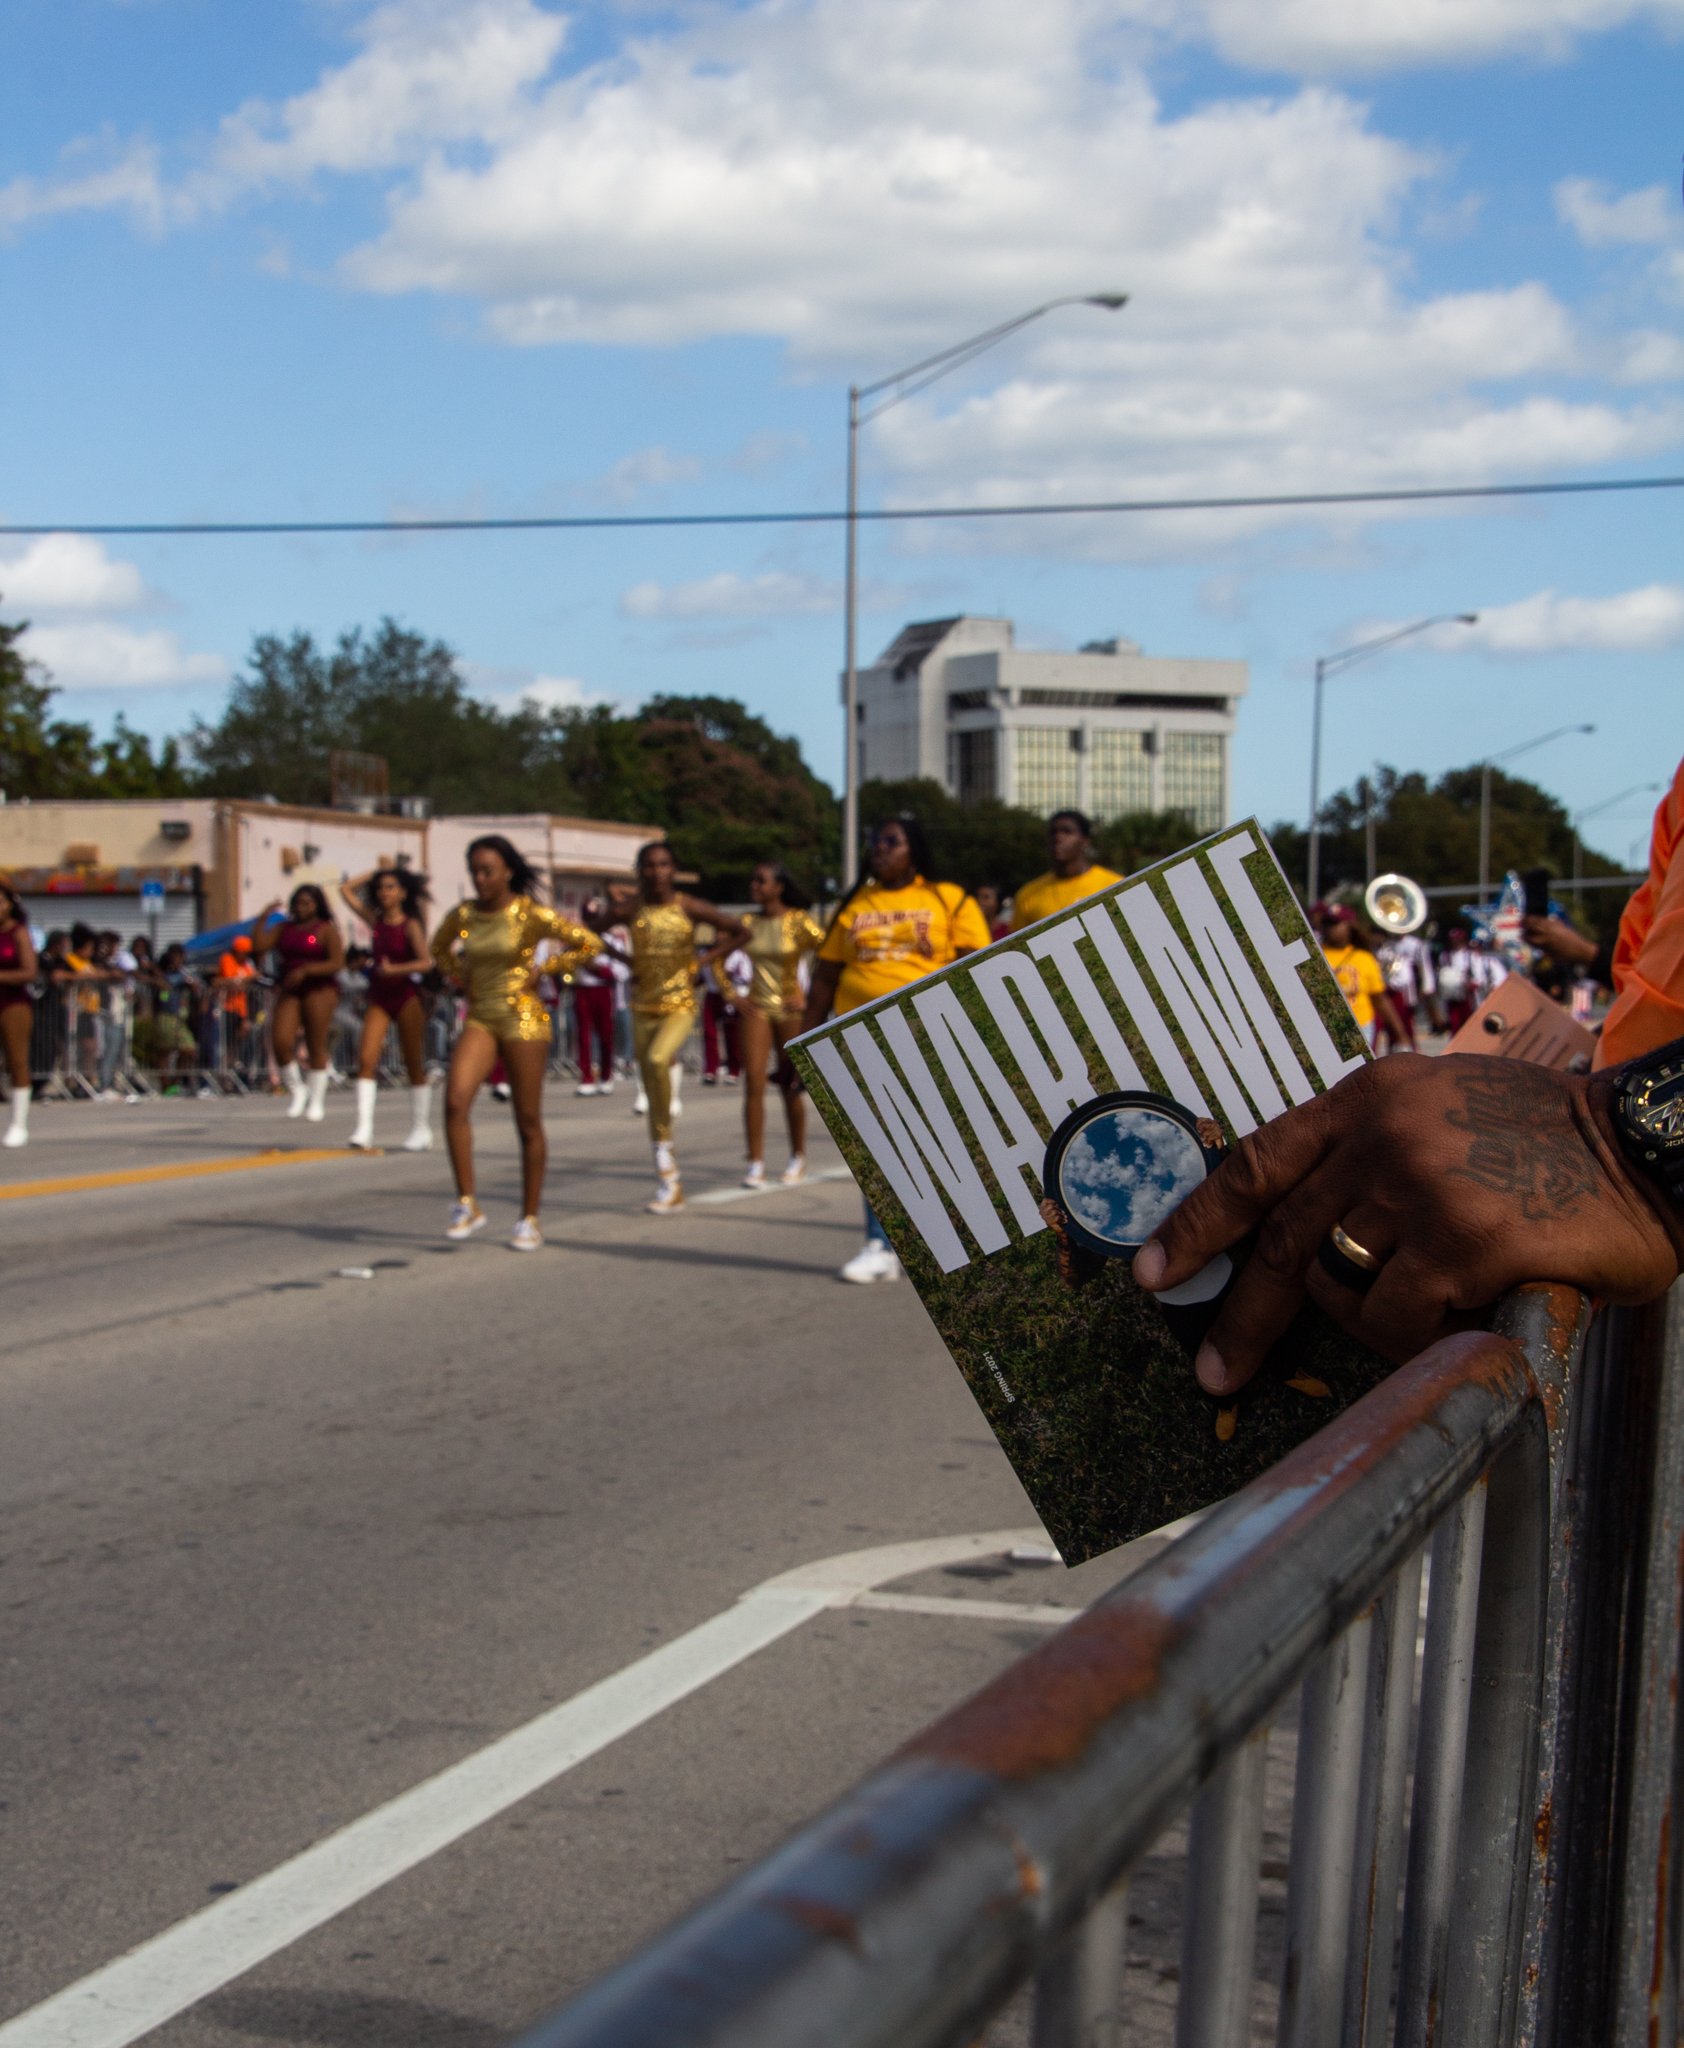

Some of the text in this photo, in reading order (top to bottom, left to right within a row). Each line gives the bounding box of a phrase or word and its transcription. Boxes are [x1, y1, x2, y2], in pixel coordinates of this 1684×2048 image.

[806, 829, 1367, 1274] WARTIME
[982, 1351, 1015, 1403] SPRING 2021
